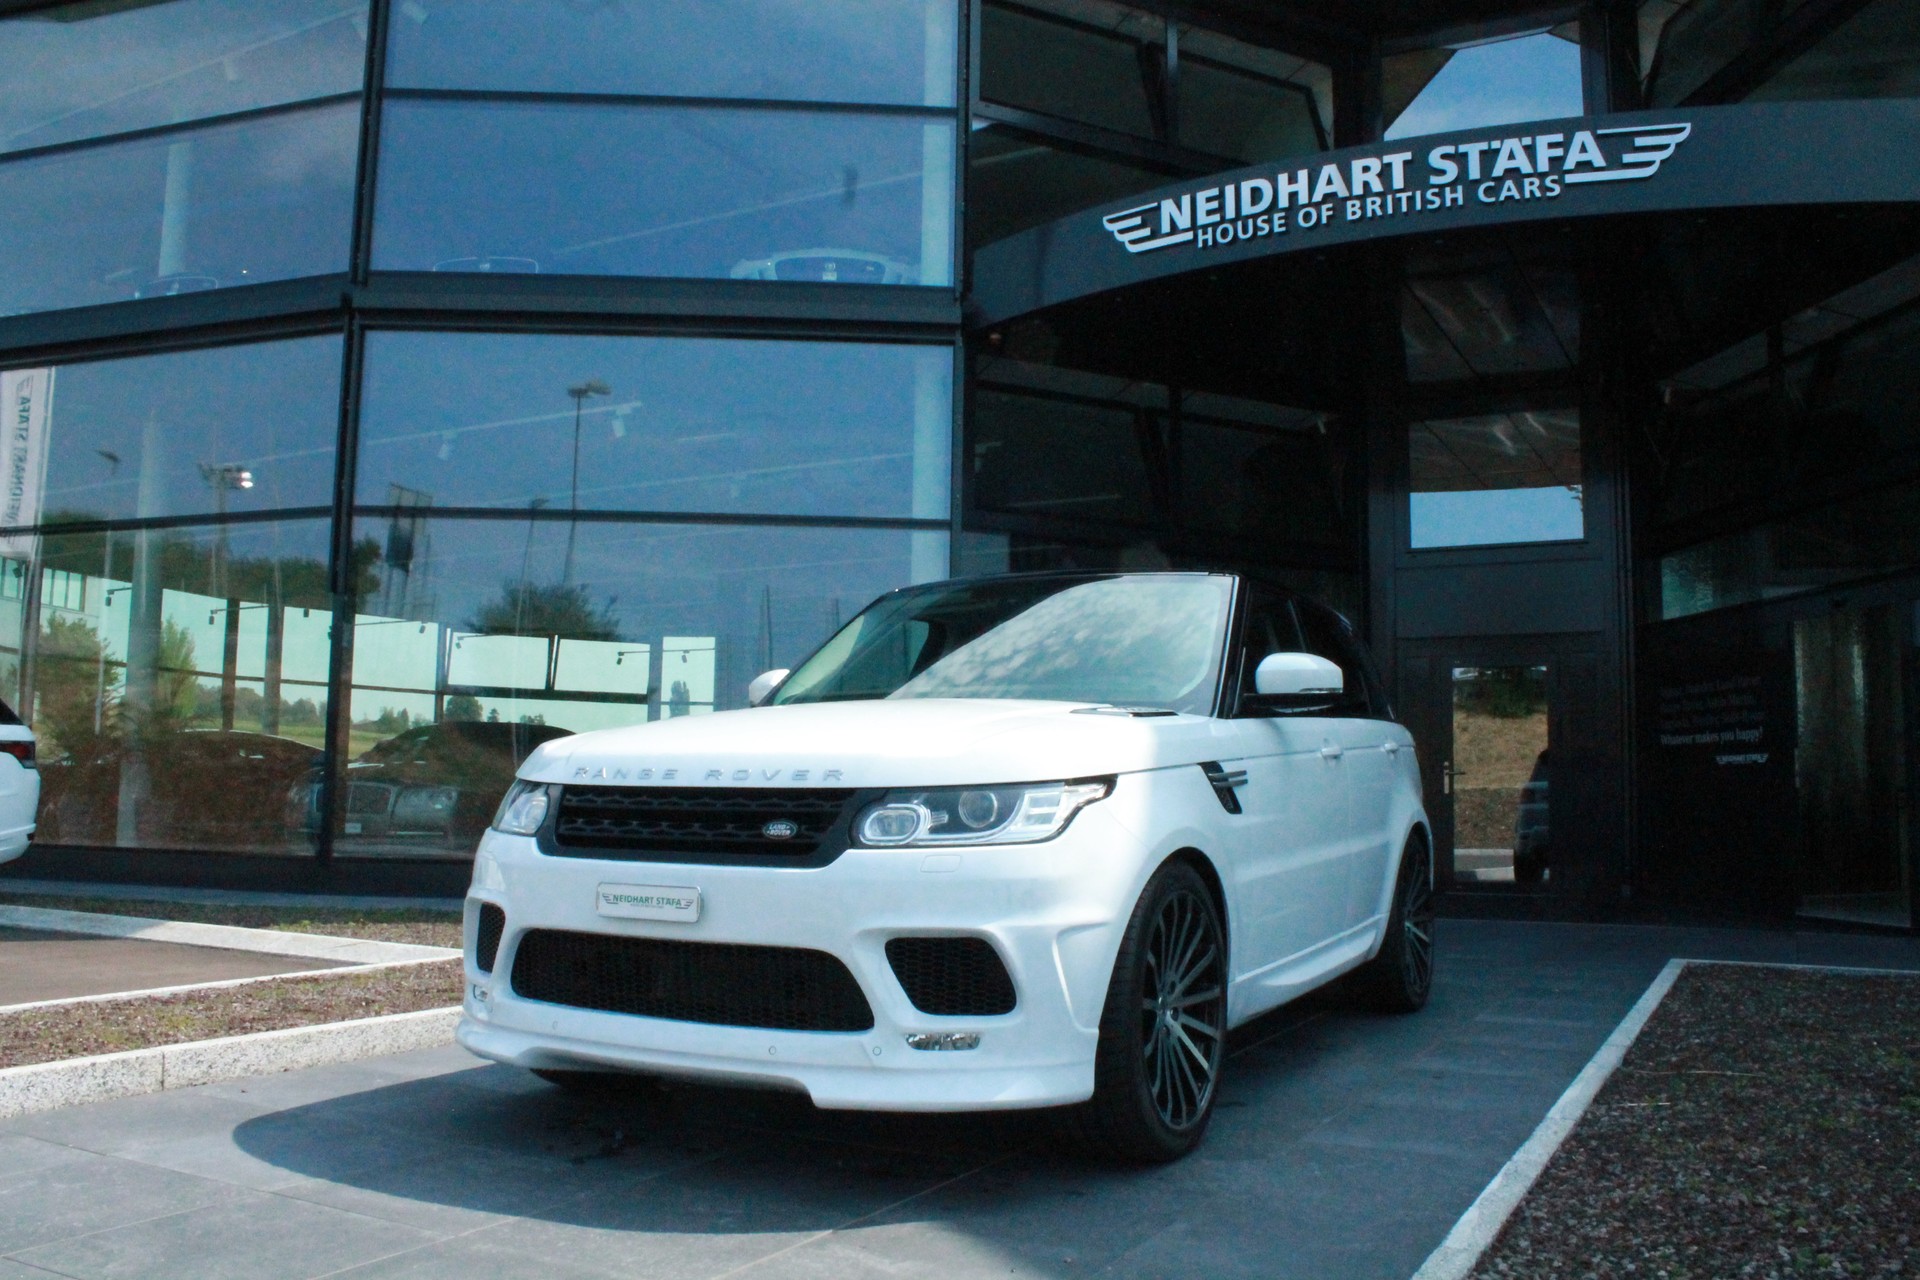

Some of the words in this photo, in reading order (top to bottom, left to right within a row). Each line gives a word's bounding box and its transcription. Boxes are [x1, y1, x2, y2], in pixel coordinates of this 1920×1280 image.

[1160, 151, 1413, 234] NEIDHART
[1428, 130, 1607, 185] STÄFA
[1196, 211, 1287, 249] HOUSE
[1300, 203, 1334, 228] OF
[1345, 185, 1465, 221] BRITISH
[1477, 175, 1562, 203] CARS
[573, 767, 680, 781] RANGE
[704, 768, 845, 782] ROVER
[613, 894, 655, 905] NEIDHART
